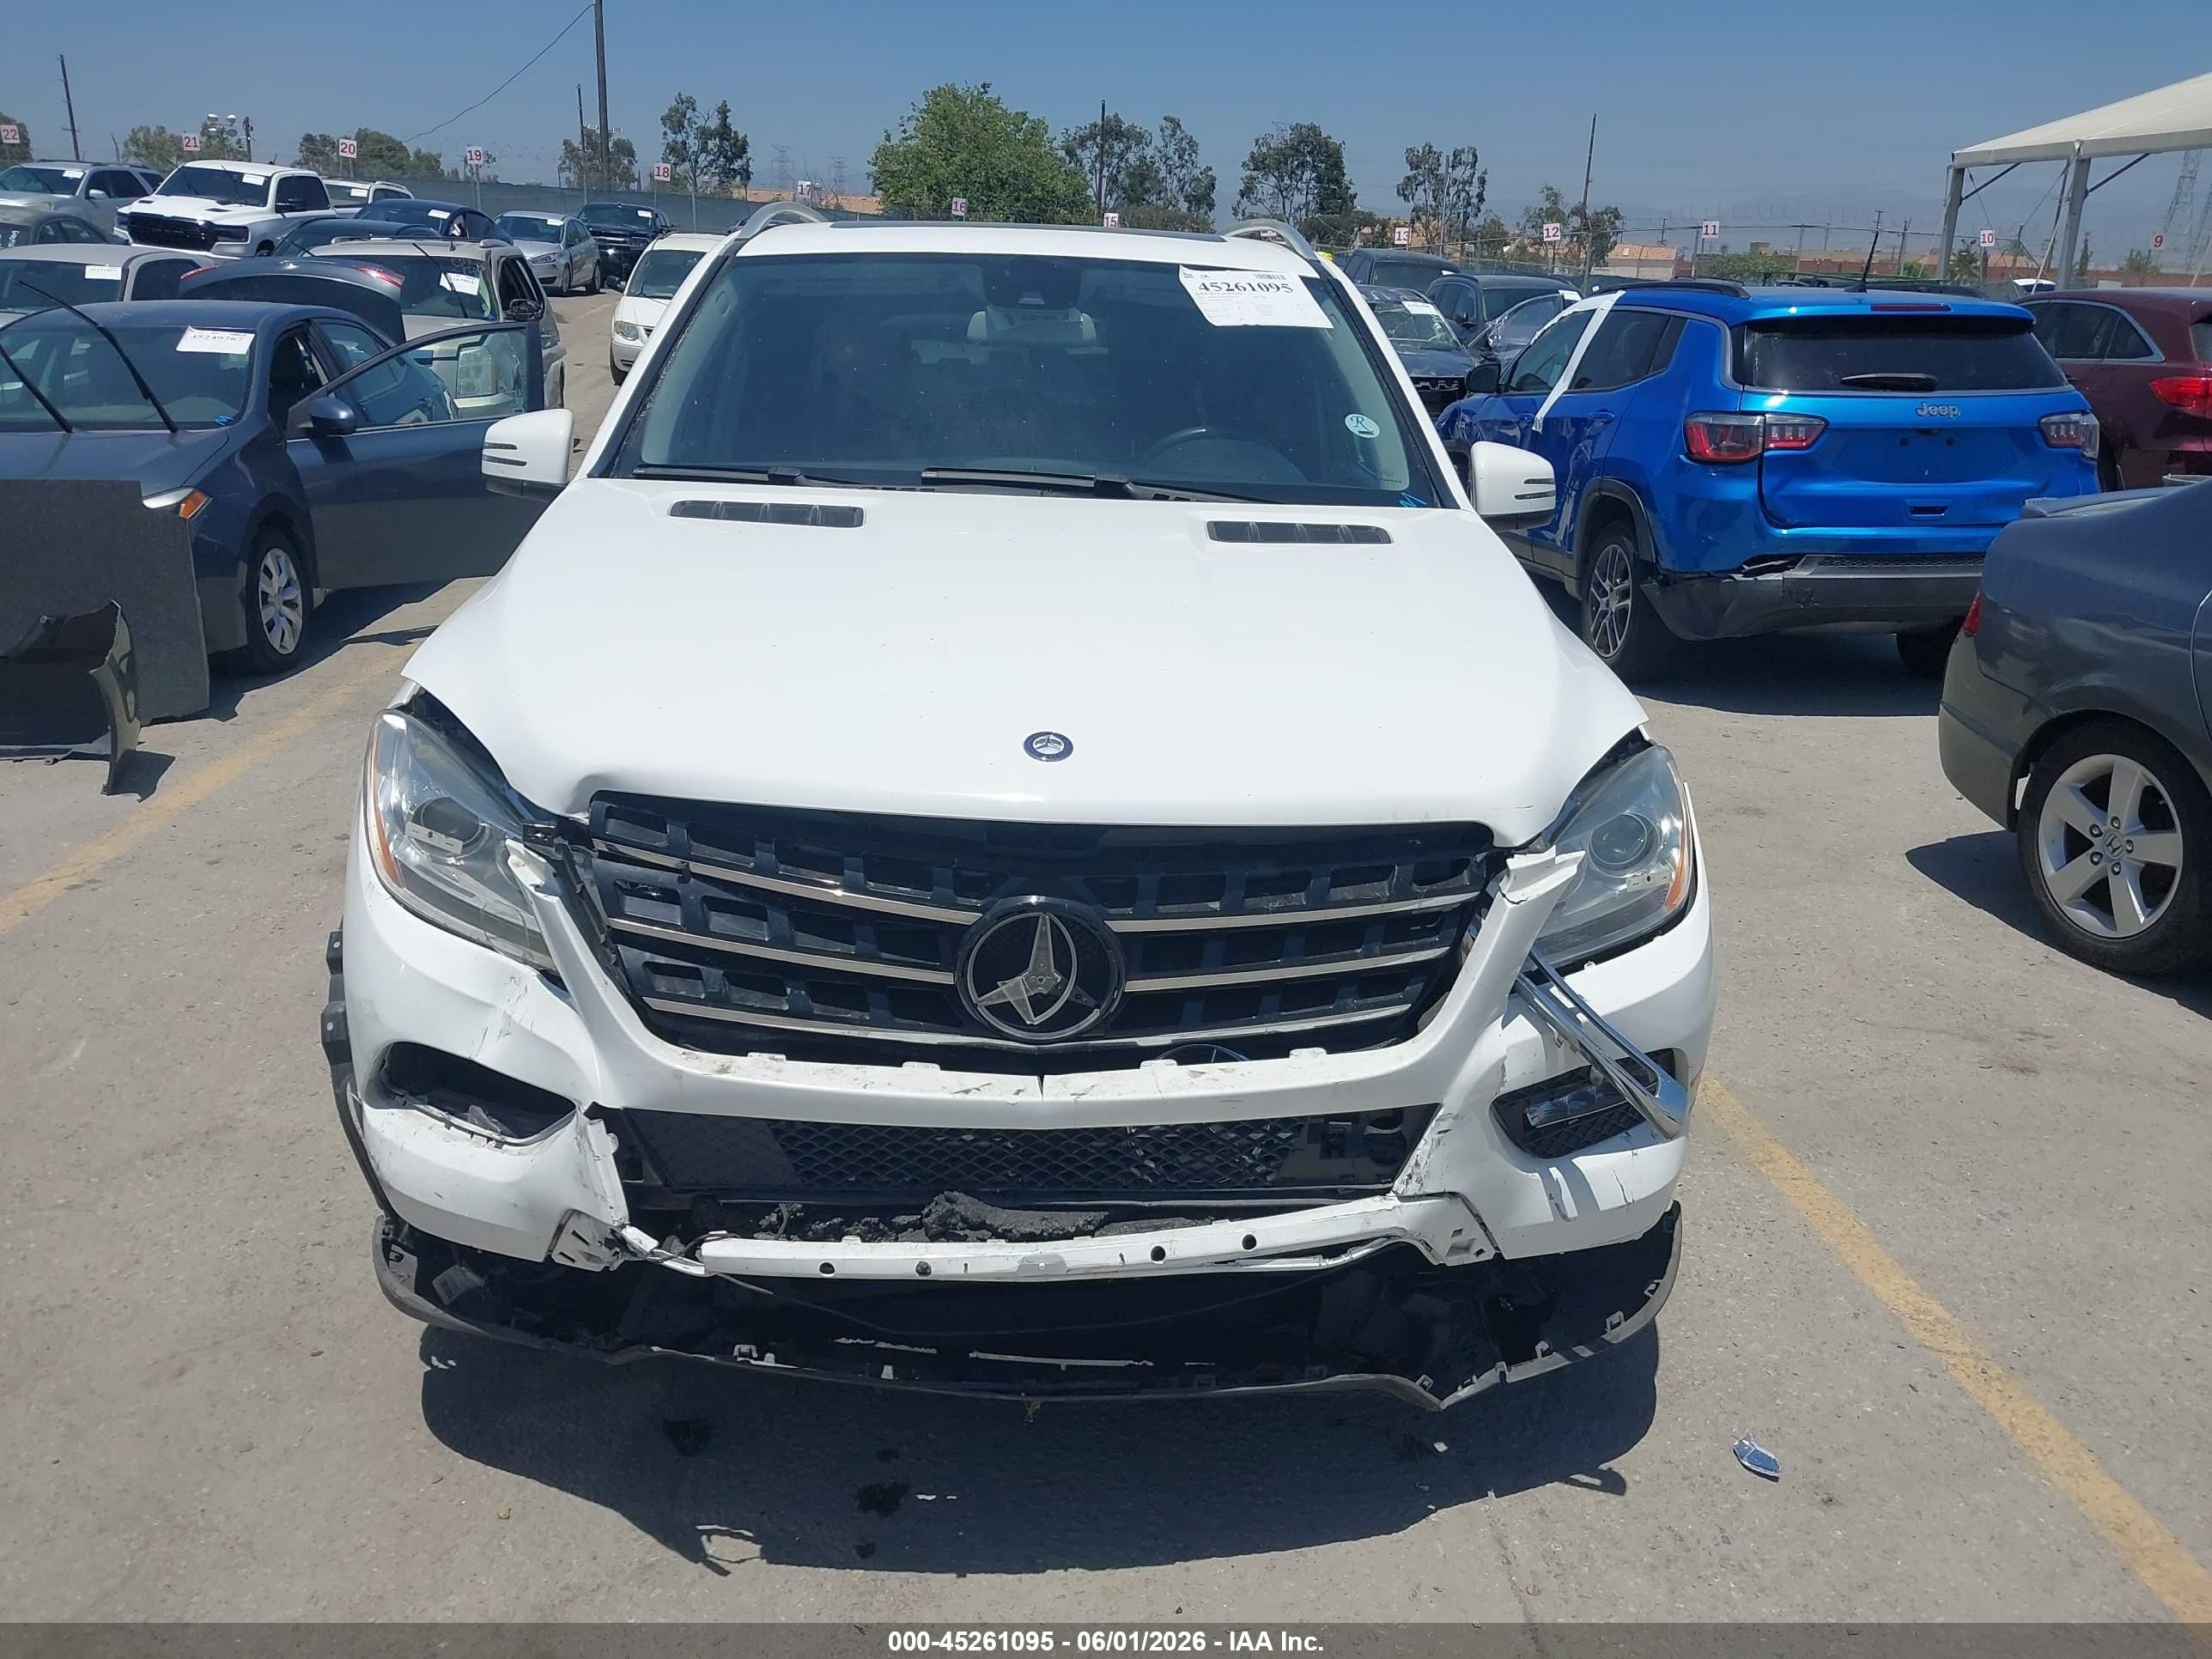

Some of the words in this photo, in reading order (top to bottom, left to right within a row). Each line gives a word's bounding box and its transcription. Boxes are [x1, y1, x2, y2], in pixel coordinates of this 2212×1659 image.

[3, 129, 18, 140] 22
[184, 136, 198, 148] 21
[341, 142, 356, 155] 20
[467, 149, 482, 161] 19
[655, 166, 669, 178] 18
[799, 185, 811, 196] 17
[953, 201, 965, 212] 16
[1104, 216, 1116, 227] 15
[1545, 227, 1559, 238] 12
[1703, 224, 1717, 235] 11
[1981, 233, 1993, 244] 10
[2154, 235, 2163, 247] 9
[1198, 280, 1293, 293] 45261095
[1916, 402, 1959, 418] Jeep
